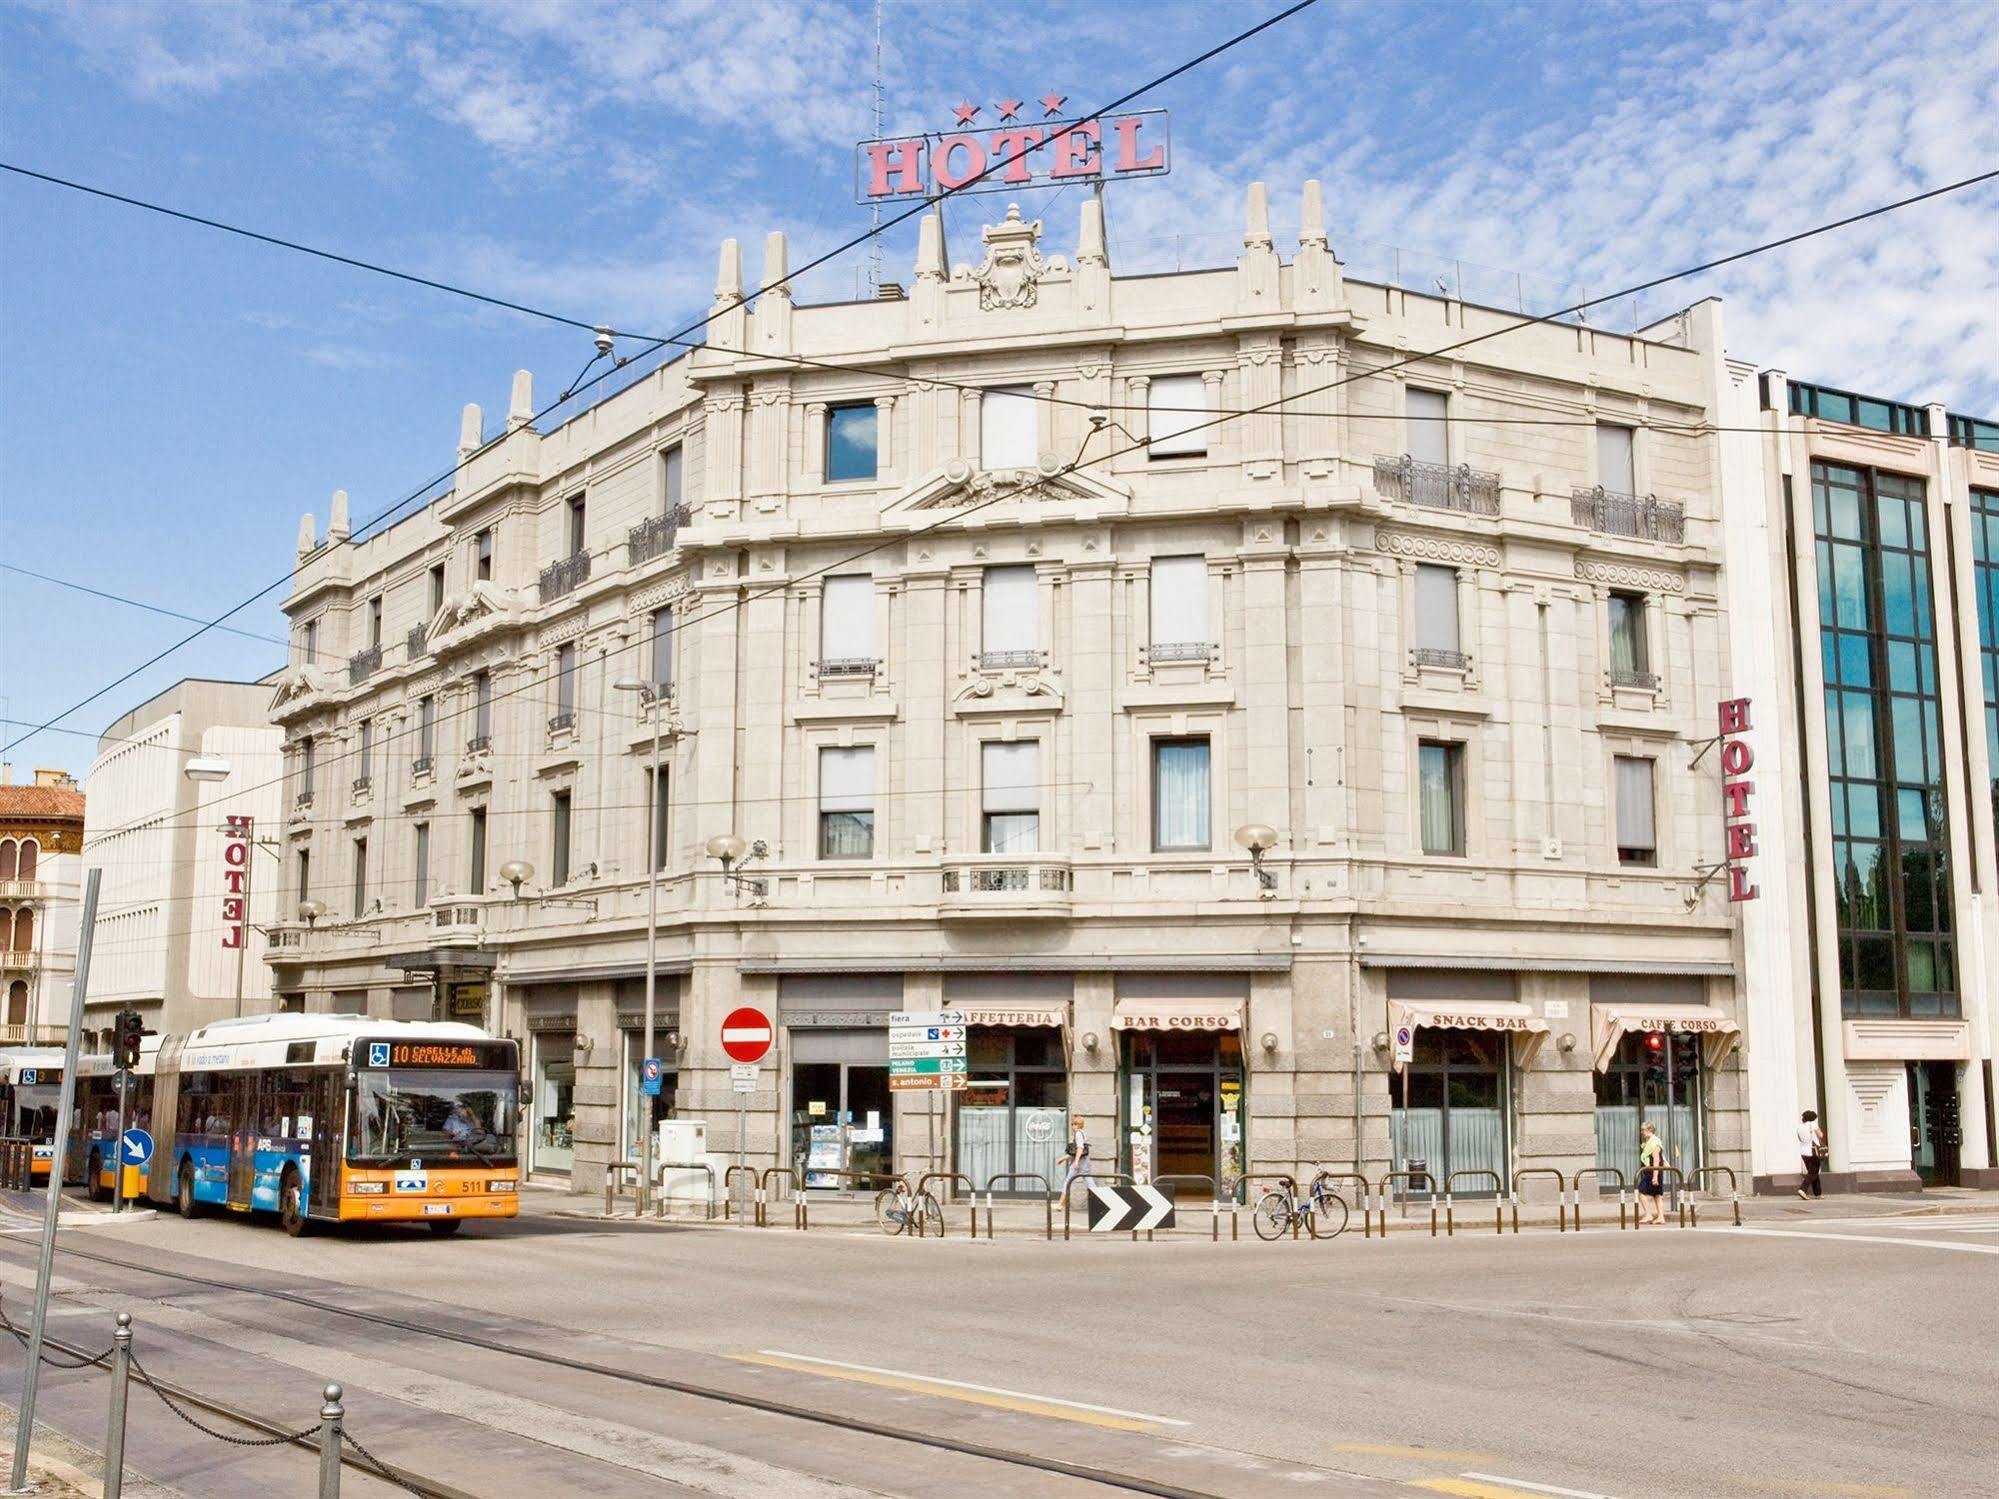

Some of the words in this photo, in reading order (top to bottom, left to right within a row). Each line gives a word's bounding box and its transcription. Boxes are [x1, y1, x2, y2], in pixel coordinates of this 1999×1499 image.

[867, 118, 1164, 197] HOTEL
[1718, 698, 1760, 902] HOTEL
[891, 1015, 910, 1023] fiera
[1124, 1016, 1160, 1027] BAR
[1168, 1016, 1229, 1027] CORSO
[1432, 1014, 1488, 1027] SNACK
[1495, 1017, 1528, 1029] BAR
[1680, 1019, 1717, 1031] CORSO
[392, 1045, 409, 1063] 10
[412, 1045, 459, 1056] CASELLE
[37, 1071, 46, 1081] 3
[462, 1180, 481, 1193] 511
